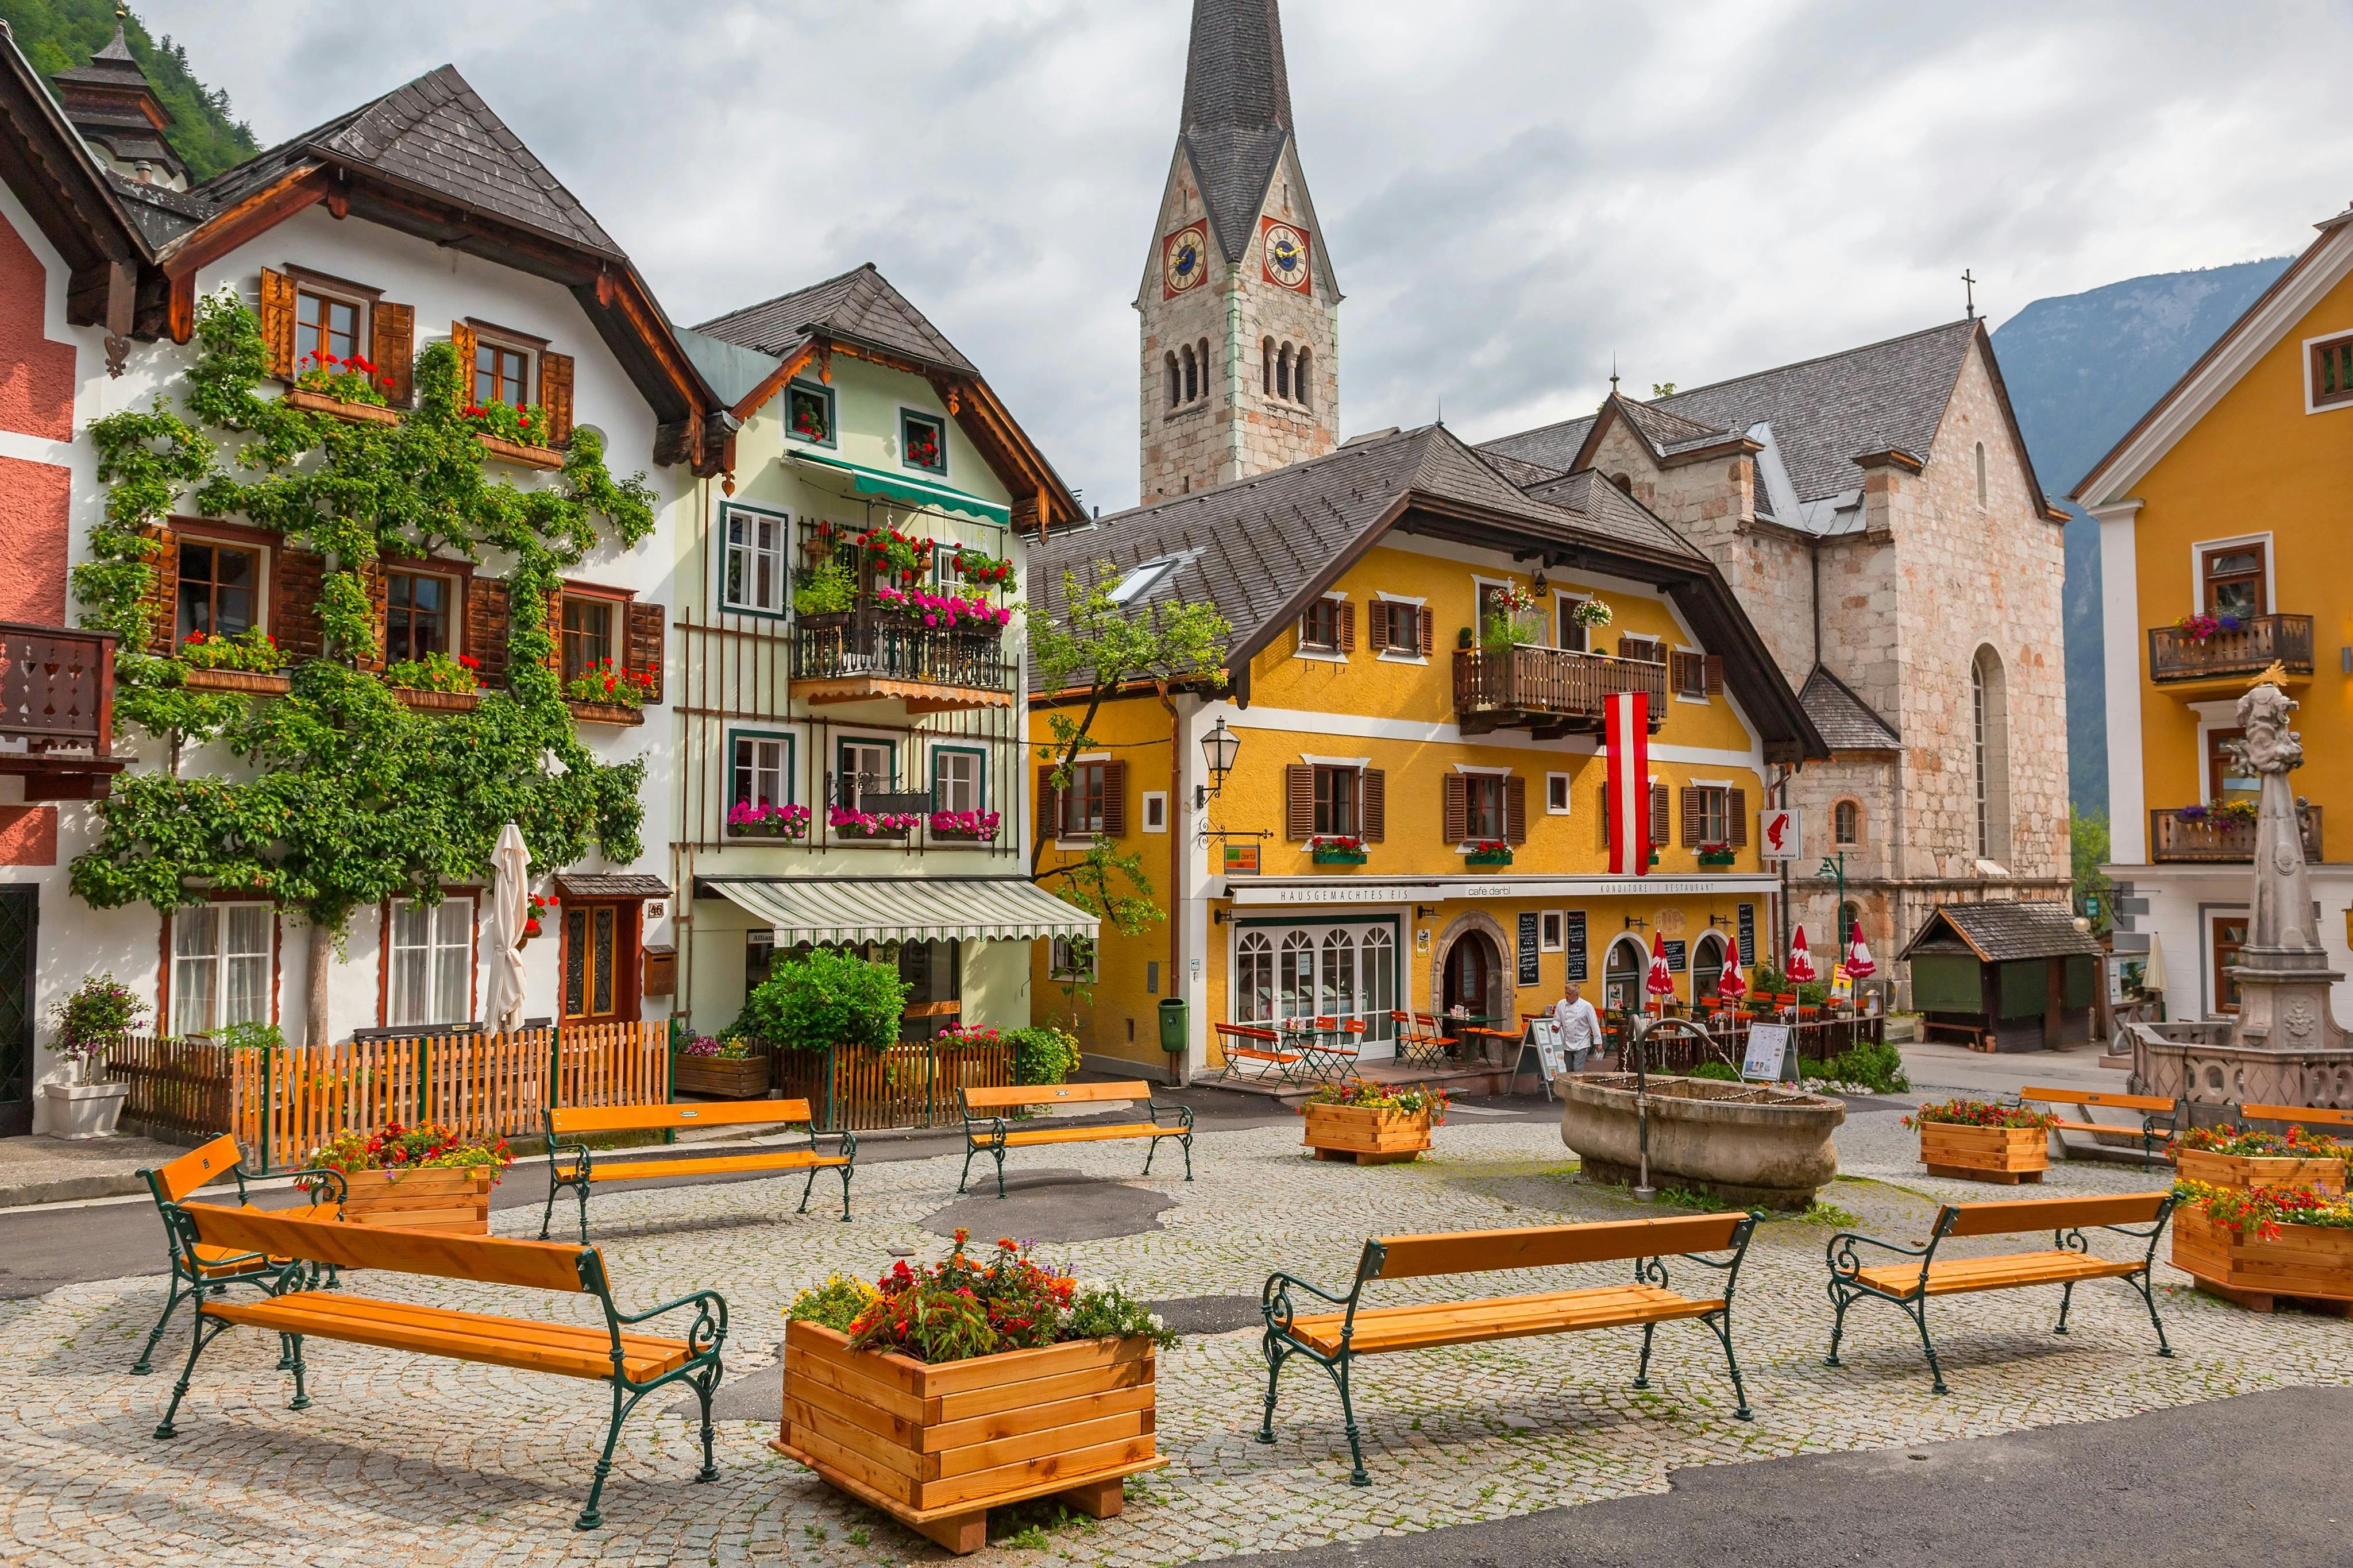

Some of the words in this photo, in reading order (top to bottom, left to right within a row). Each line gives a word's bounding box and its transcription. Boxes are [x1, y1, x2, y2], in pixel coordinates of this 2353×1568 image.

[1468, 886, 1487, 895] café
[1600, 885, 1652, 893] KONDITOREI
[1666, 883, 1714, 892] RESTAURANT
[1281, 890, 1382, 900] HAUSGEMACHTES
[1391, 890, 1407, 899] EIS
[651, 905, 662, 916] 46
